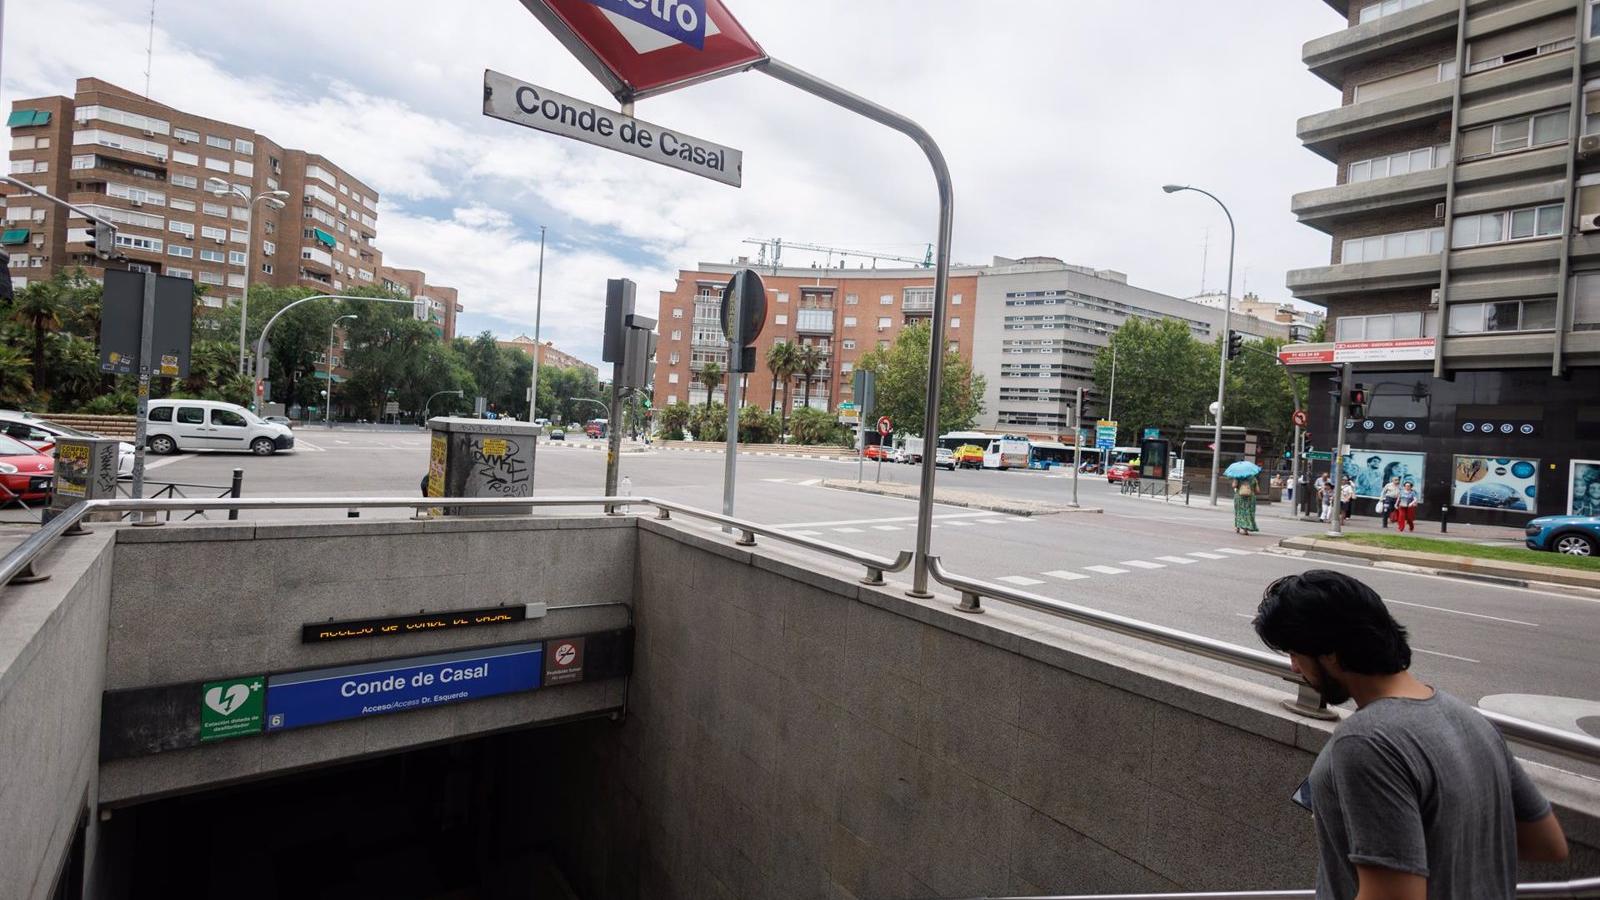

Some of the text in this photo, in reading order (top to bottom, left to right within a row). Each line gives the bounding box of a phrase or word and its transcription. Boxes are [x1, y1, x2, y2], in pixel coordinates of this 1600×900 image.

[515, 86, 725, 172] Conde de Casal
[341, 662, 488, 698] Conde de Casal
[422, 696, 432, 704] Dr.
[433, 690, 469, 704] Esquerdo
[272, 715, 281, 726] 6
